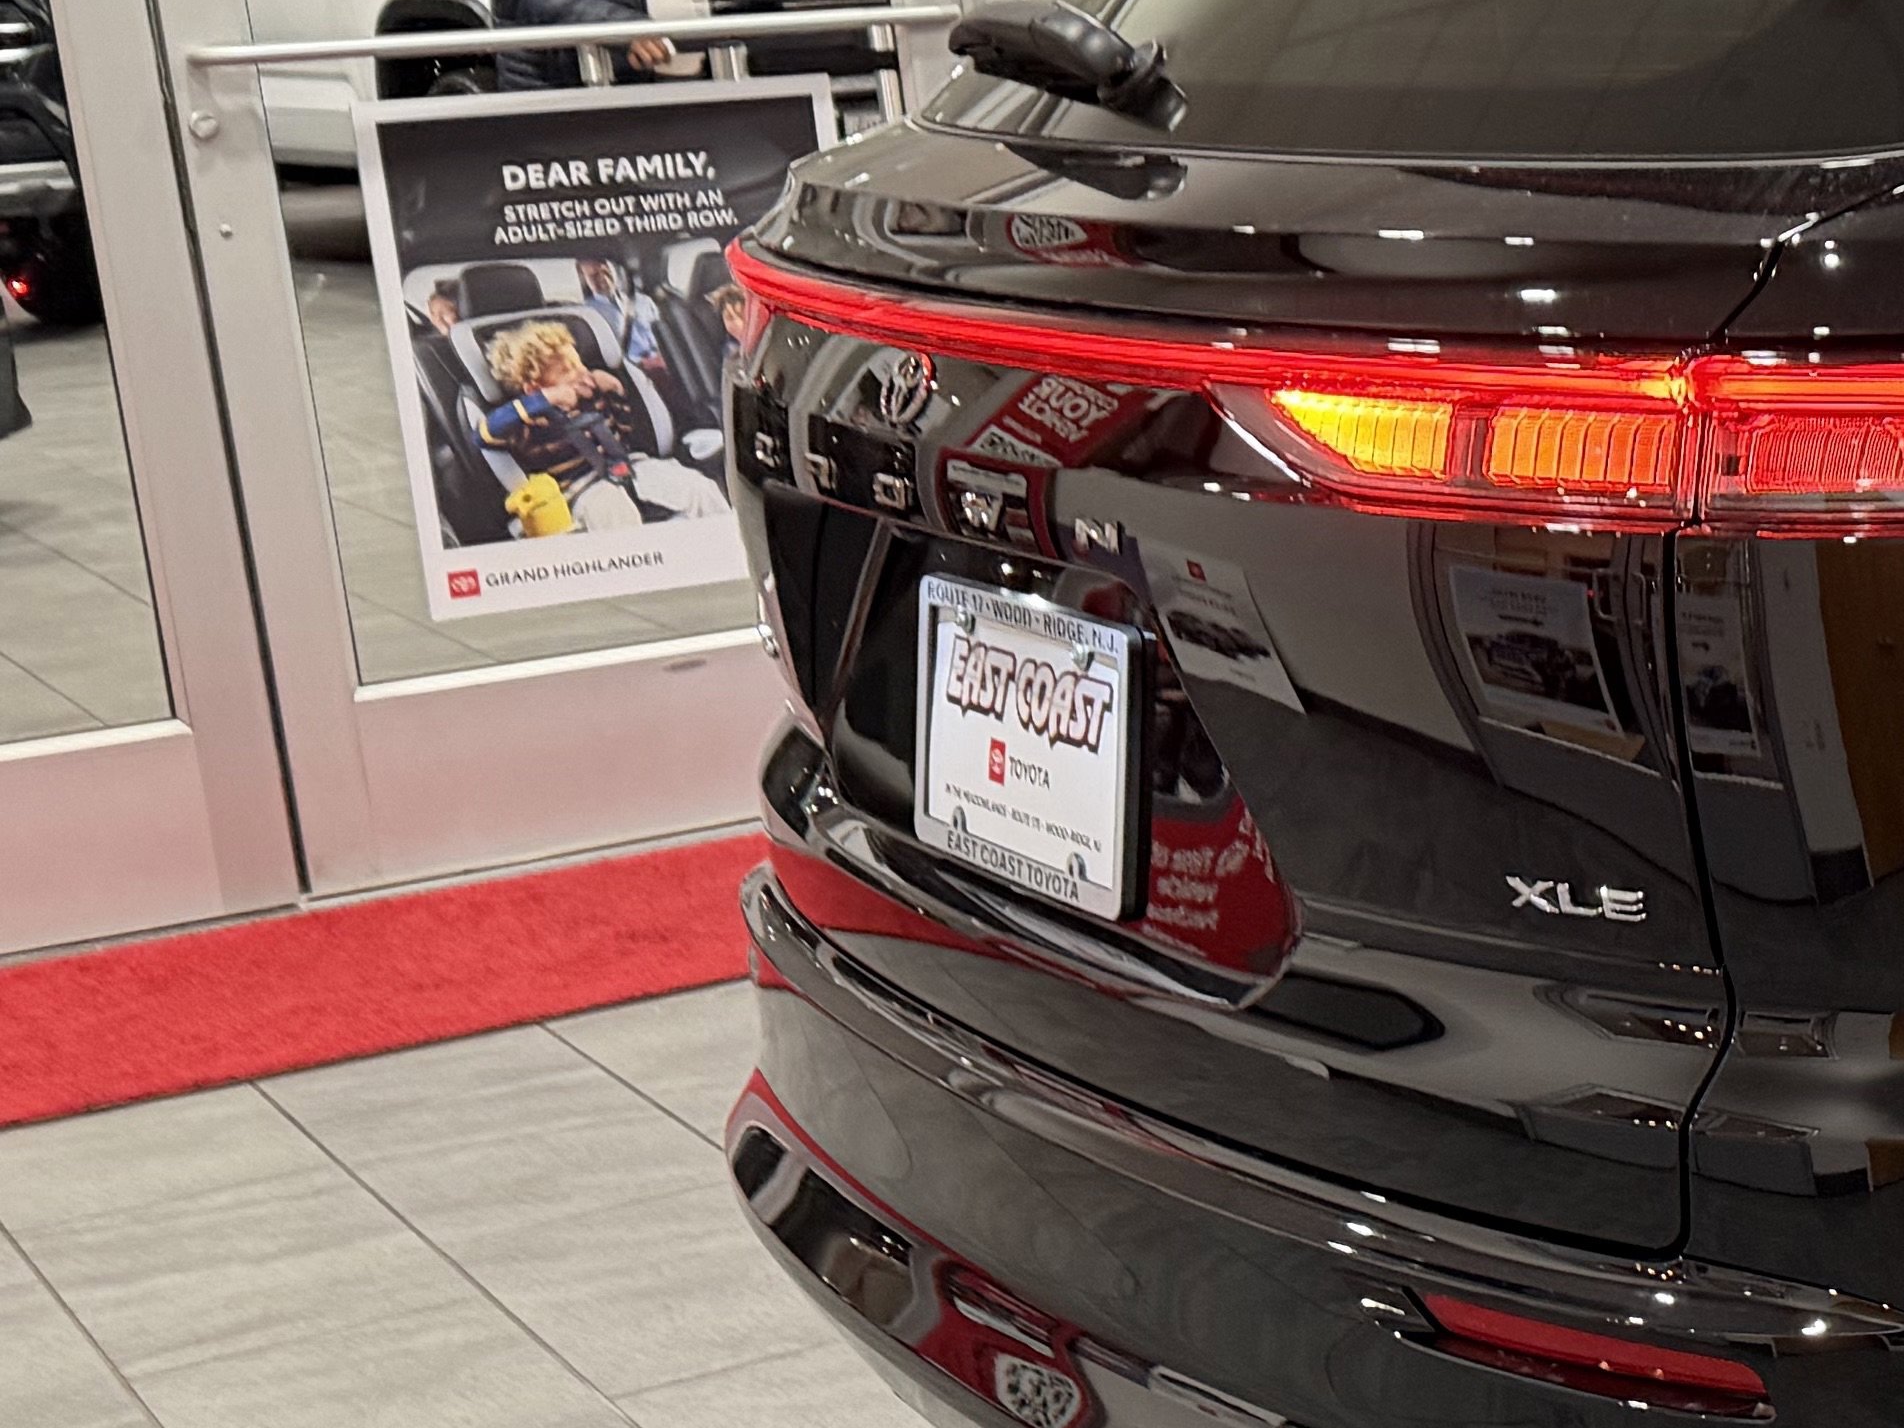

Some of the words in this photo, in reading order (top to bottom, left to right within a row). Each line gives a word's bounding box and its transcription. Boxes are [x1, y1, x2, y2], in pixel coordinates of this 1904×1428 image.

[502, 160, 592, 191] DEAR
[597, 150, 716, 185] FAMILY,
[503, 199, 590, 223] STRETCH
[594, 195, 636, 216] OUT
[639, 191, 691, 212] WITH
[695, 187, 724, 208] AN
[494, 219, 621, 245] ADULT-SIZED
[624, 213, 683, 234] THIRD
[686, 207, 739, 230] ROW.
[485, 566, 550, 588] GRAND
[552, 551, 665, 581] HIGHLANDER
[927, 580, 968, 609] ROUTE
[946, 633, 1017, 723] EAST
[1016, 658, 1114, 755] COAST
[1008, 756, 1051, 791] TOYOTA
[947, 829, 977, 860] EAST
[980, 843, 1024, 879] COAST
[1026, 862, 1081, 903] TOYOTA
[1505, 874, 1647, 922] XLE
